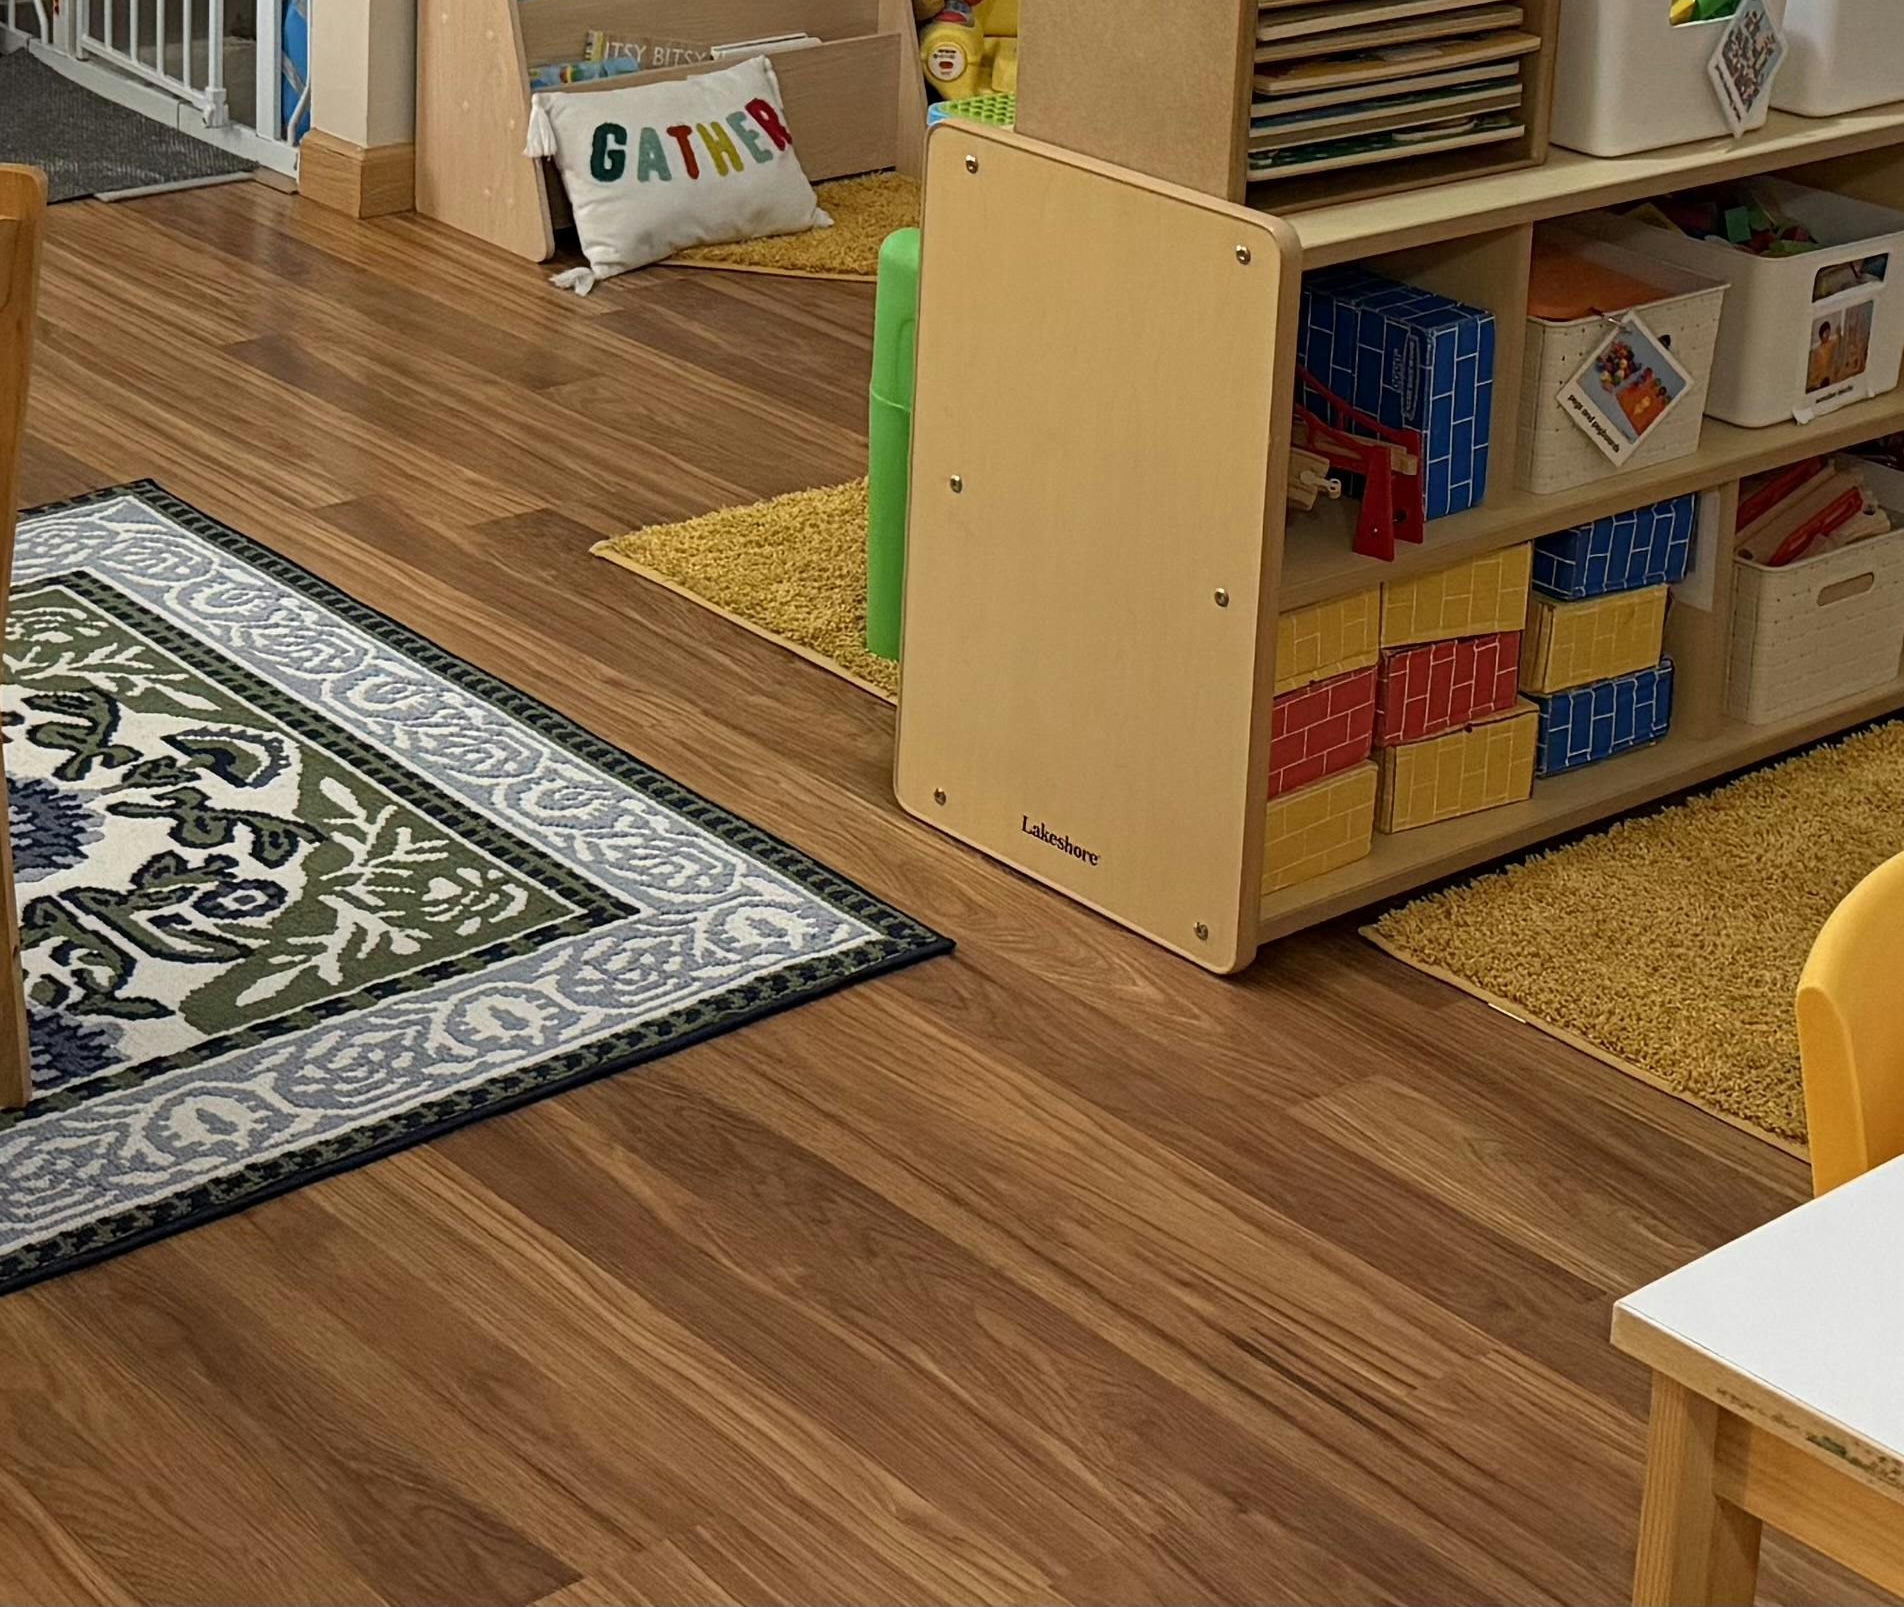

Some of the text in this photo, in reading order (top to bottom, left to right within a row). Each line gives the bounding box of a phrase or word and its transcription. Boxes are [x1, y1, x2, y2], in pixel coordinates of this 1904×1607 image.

[653, 47, 707, 68] BITSY
[590, 97, 794, 182] GATHER
[1564, 393, 1585, 415] pegs
[1578, 407, 1597, 426] and
[1020, 813, 1100, 866] Lakeshore
